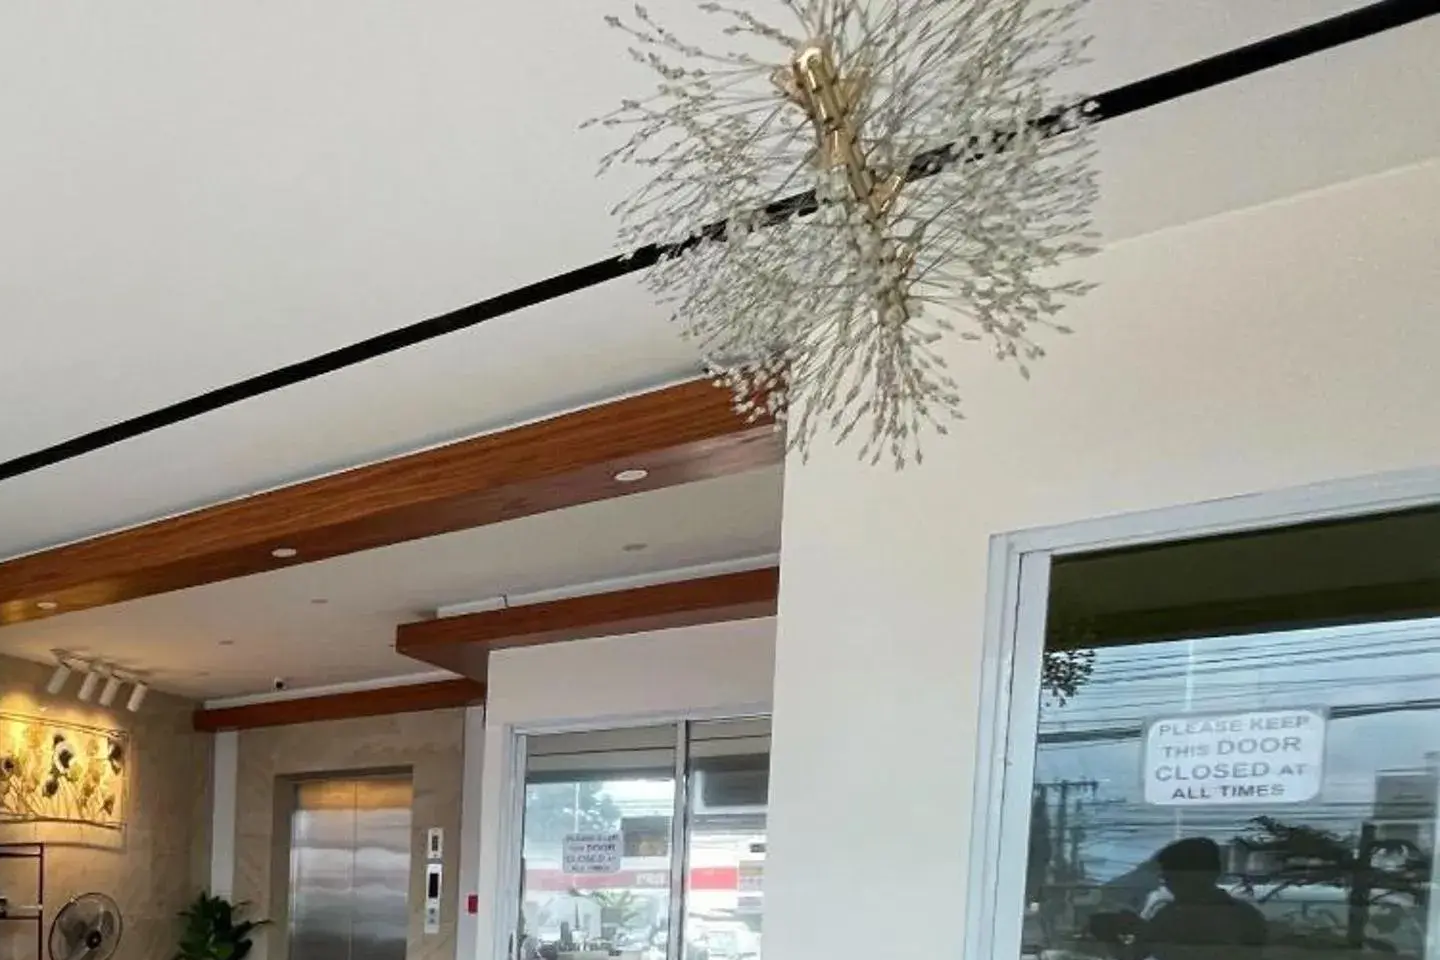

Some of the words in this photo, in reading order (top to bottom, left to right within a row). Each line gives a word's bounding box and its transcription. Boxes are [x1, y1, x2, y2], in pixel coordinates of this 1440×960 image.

[1159, 719, 1243, 736] PLEASE
[1250, 715, 1309, 731] KEEP
[1163, 744, 1209, 759] THIS
[1216, 737, 1302, 755] DOOR
[1155, 762, 1271, 781] CLOSED
[1278, 763, 1309, 777] AT
[1171, 786, 1211, 800] ALL
[1220, 783, 1285, 797] TIMES
